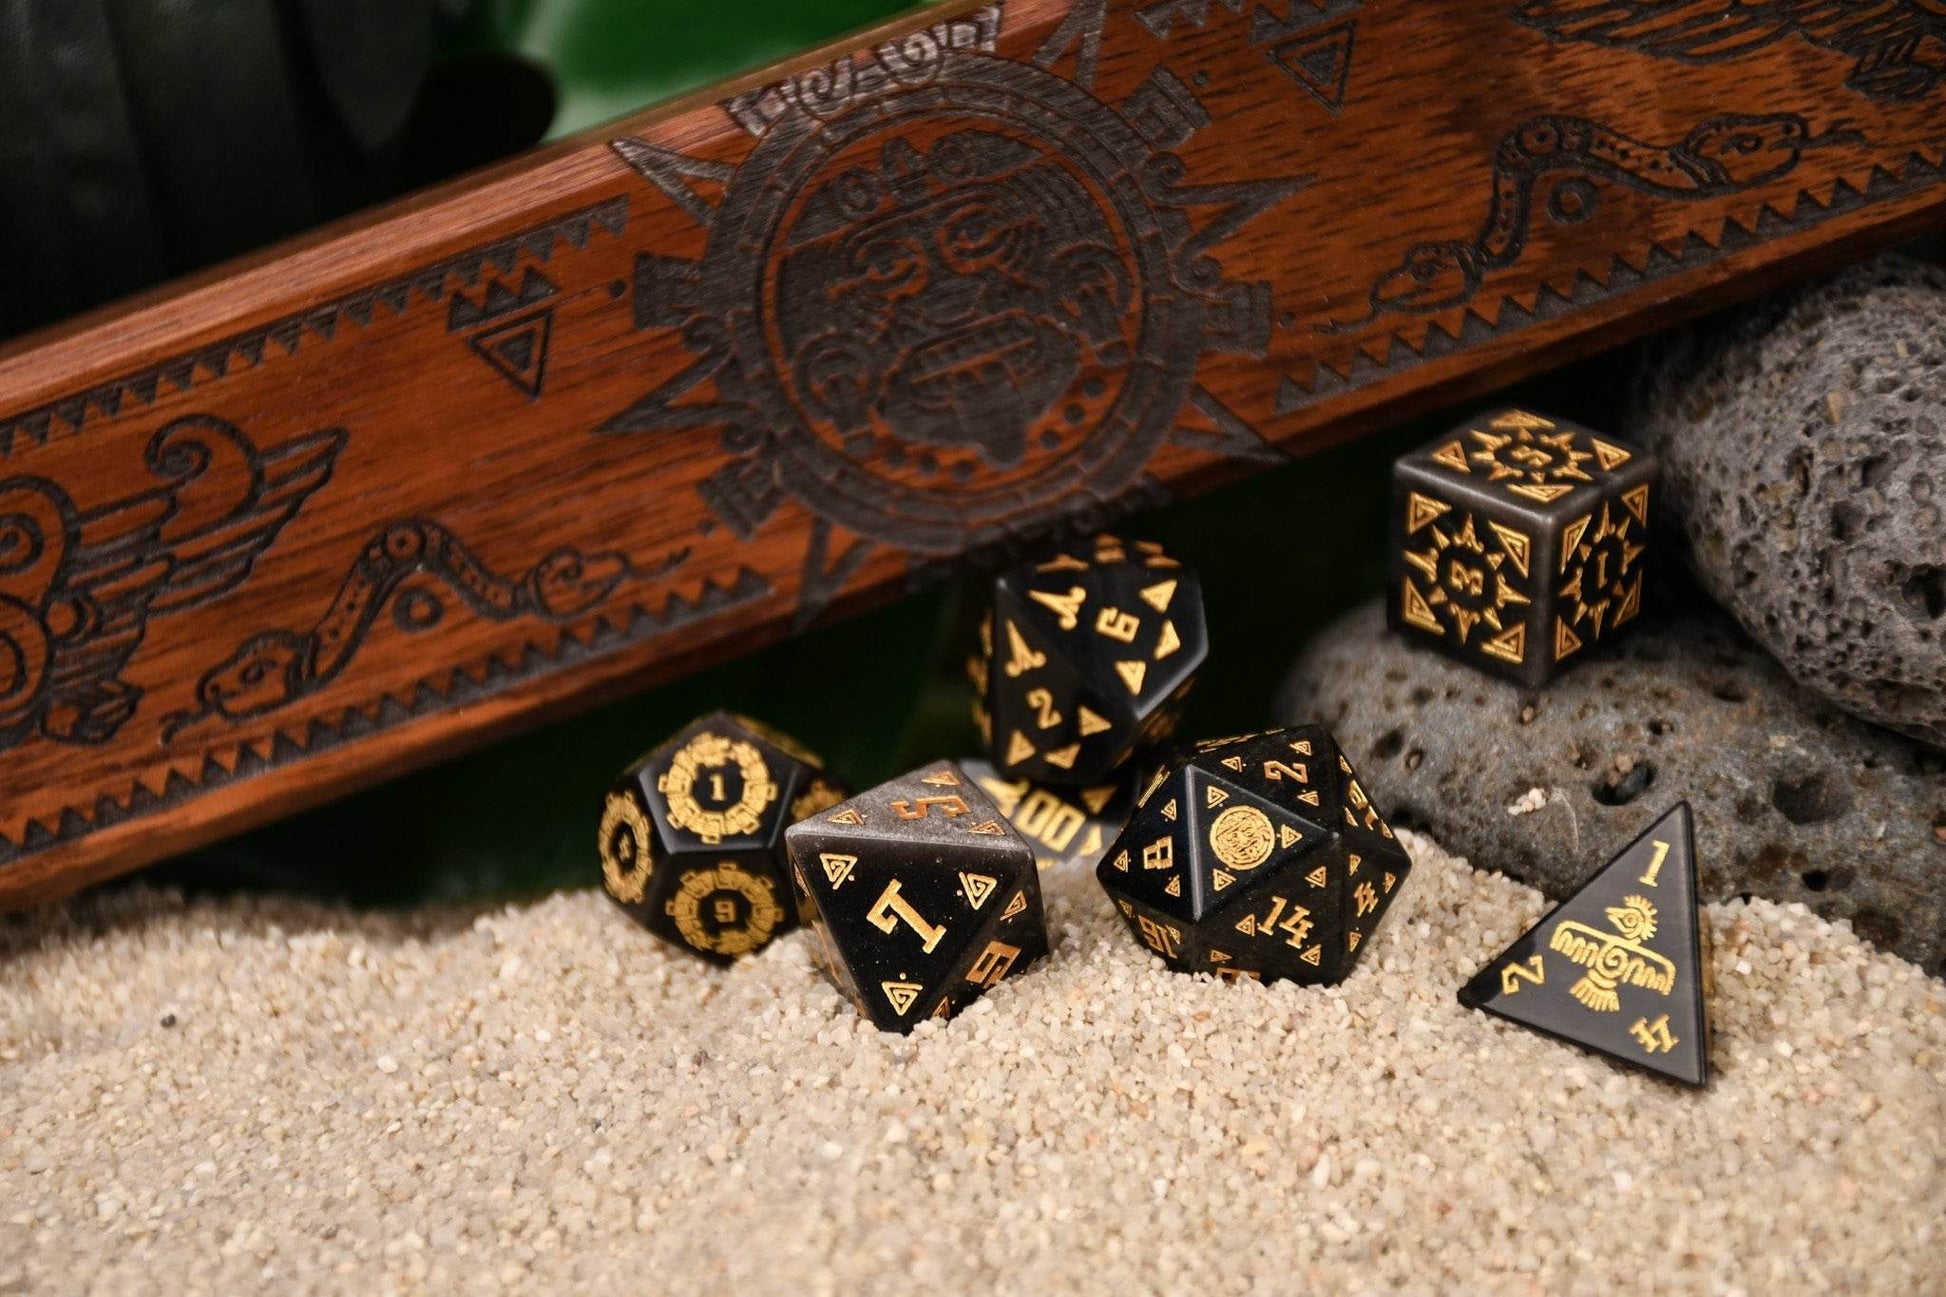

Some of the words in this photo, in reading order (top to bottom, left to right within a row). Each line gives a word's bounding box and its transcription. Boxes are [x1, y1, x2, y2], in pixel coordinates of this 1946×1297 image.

[1450, 559, 1484, 596] 3
[1026, 689, 1062, 730] 2
[709, 773, 725, 800] 1
[1263, 760, 1308, 784] 2
[1143, 836, 1173, 869] 8
[1638, 839, 1670, 887] 1
[1259, 896, 1314, 949] 14
[1501, 954, 1545, 995] 2
[1630, 1013, 1680, 1053] 4
